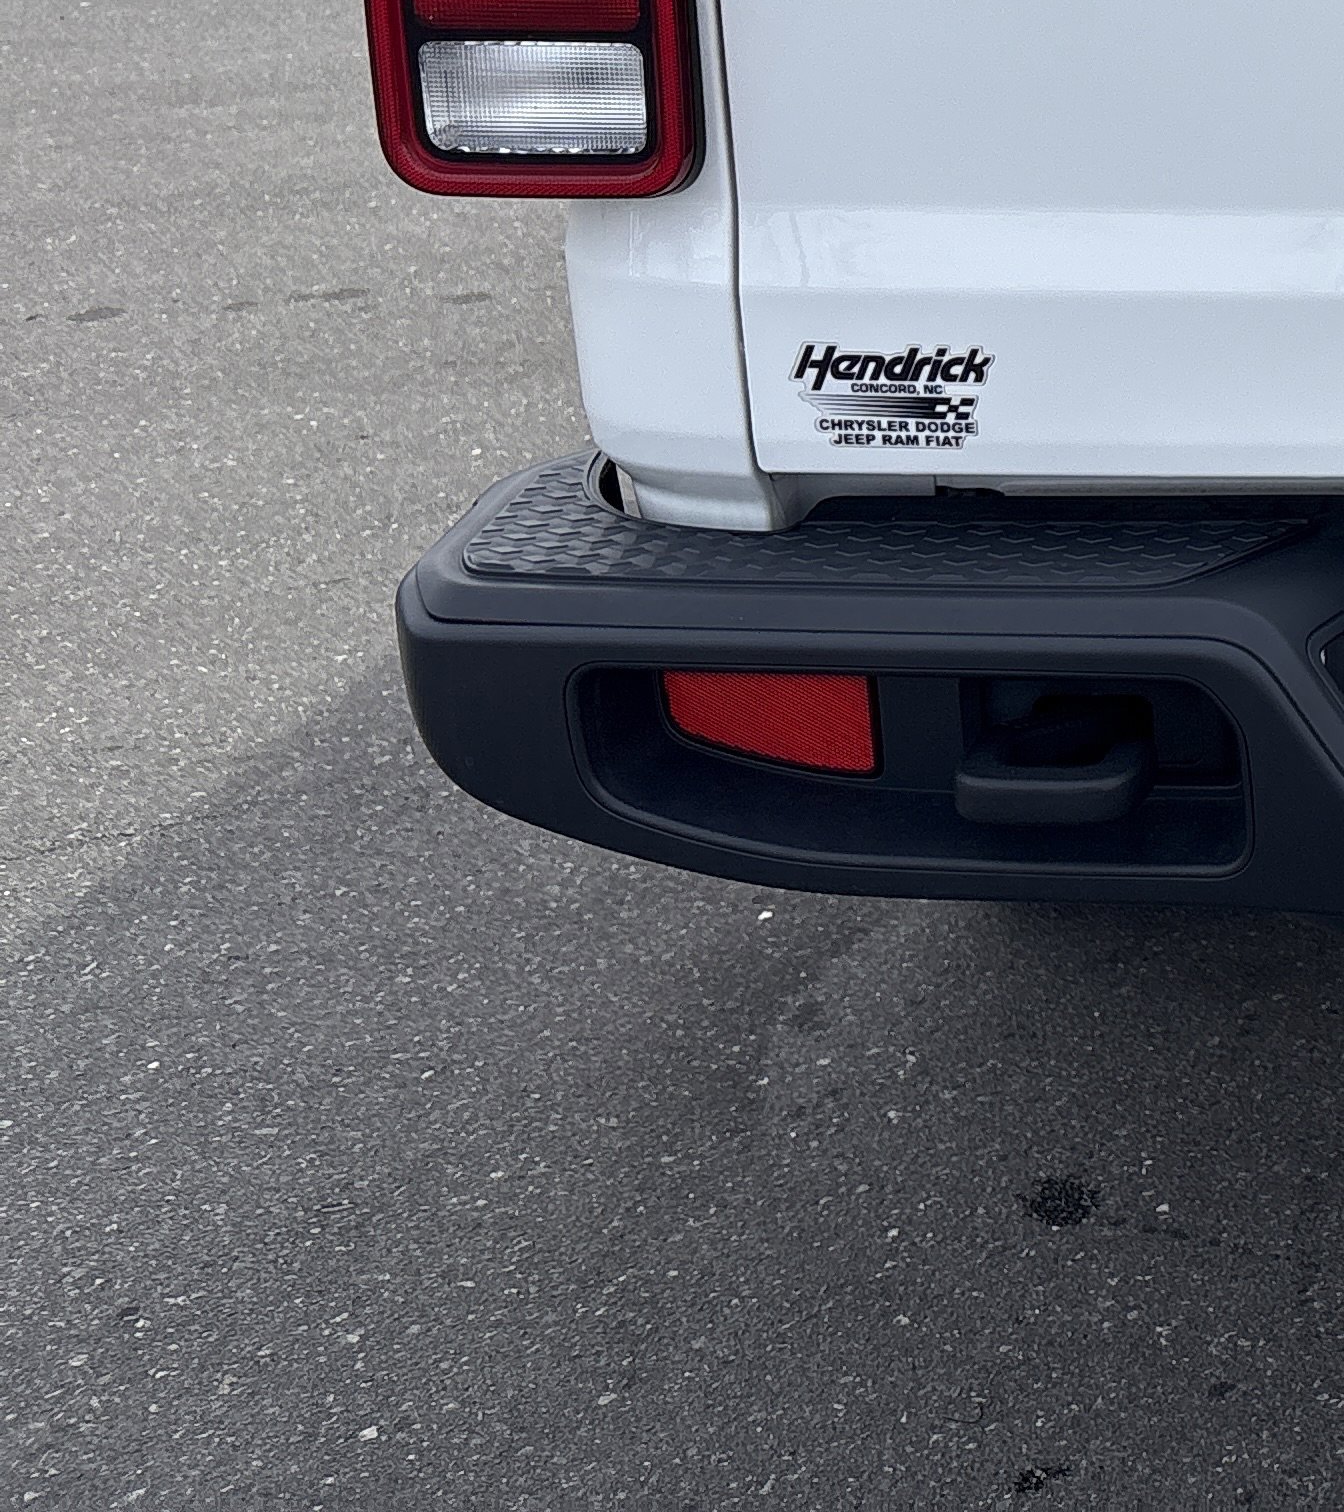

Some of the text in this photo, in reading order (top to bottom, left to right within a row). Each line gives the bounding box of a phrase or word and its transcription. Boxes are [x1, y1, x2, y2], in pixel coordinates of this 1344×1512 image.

[793, 344, 992, 391] Hendrick
[850, 381, 944, 395] CONCORD, NC
[818, 418, 976, 434] CHRYSLER DODGE
[833, 433, 964, 447] JEEP RAM FIAT
